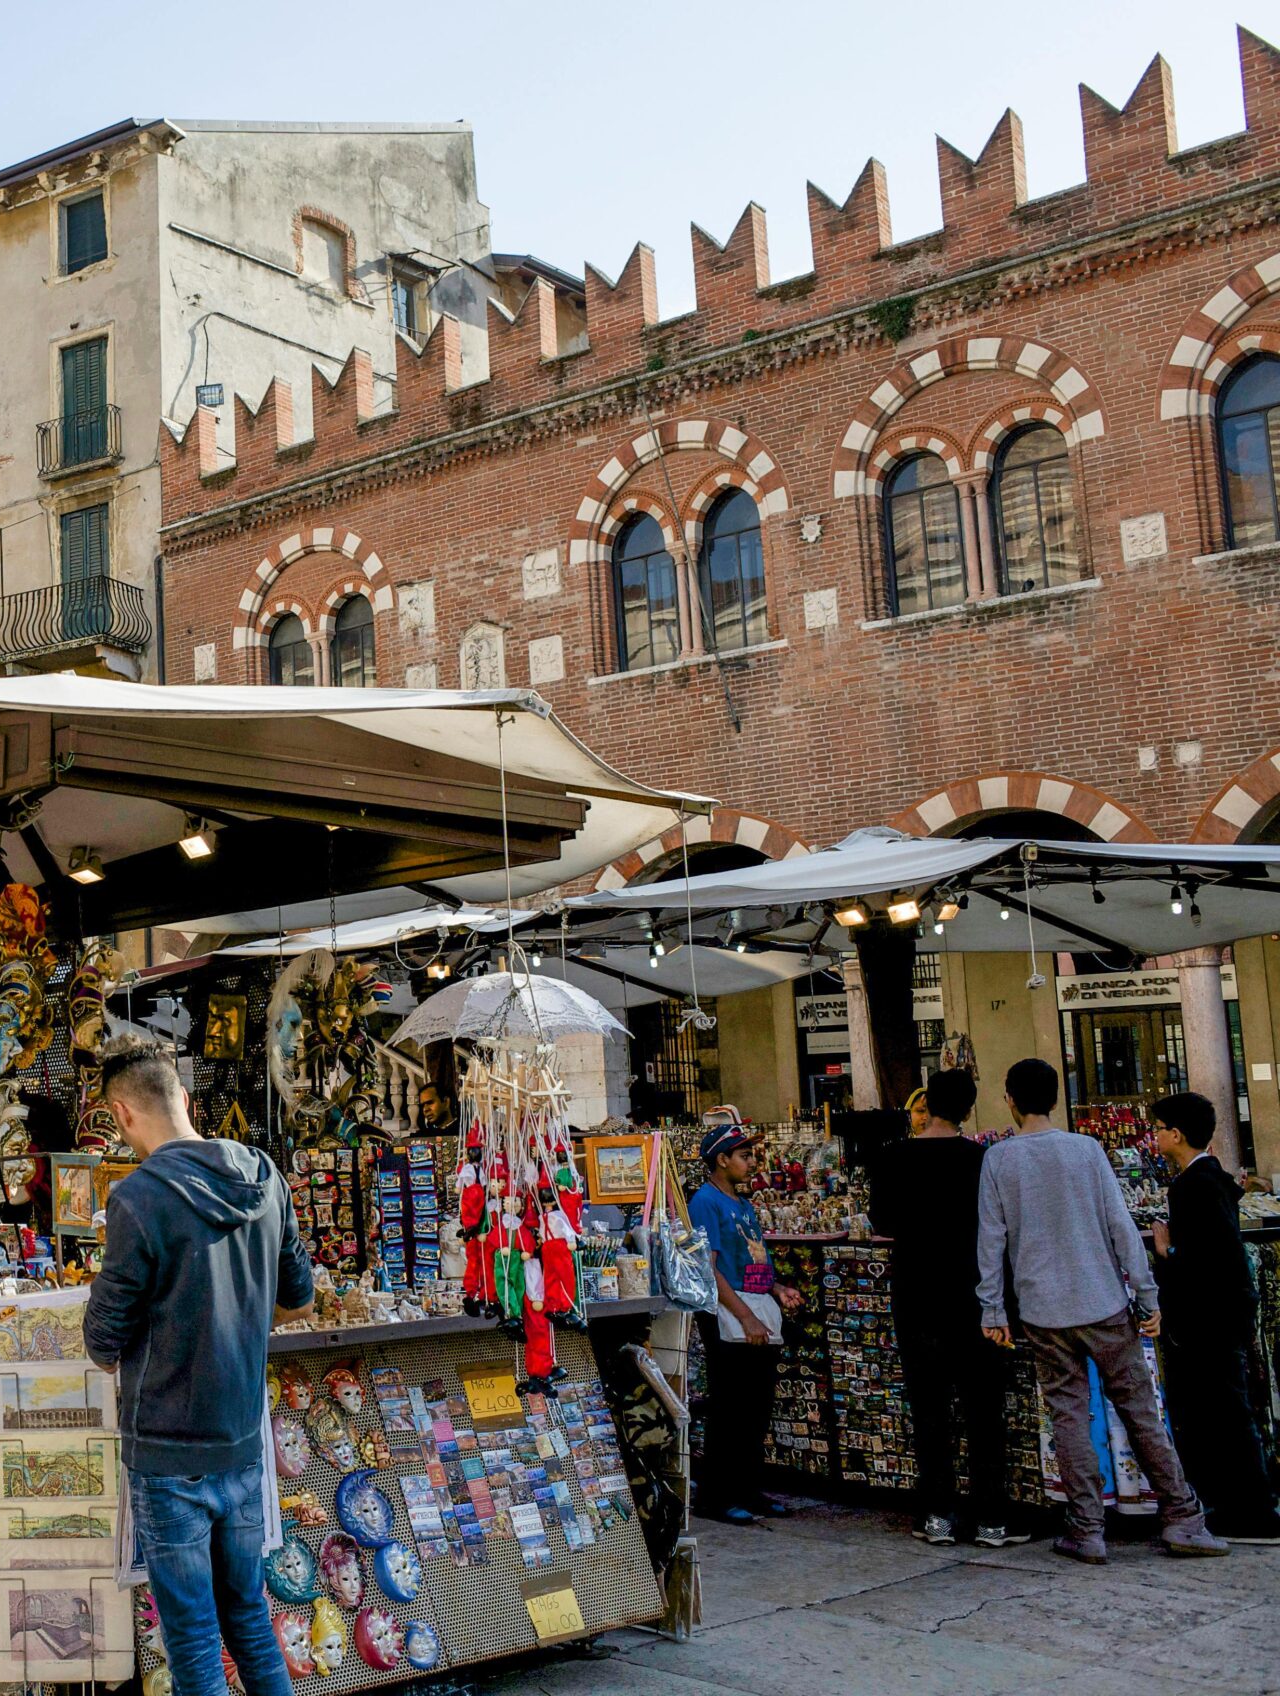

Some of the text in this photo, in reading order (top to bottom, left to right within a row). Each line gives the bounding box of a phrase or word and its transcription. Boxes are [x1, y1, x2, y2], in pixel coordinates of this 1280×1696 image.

[1080, 979, 1137, 990] BANCA
[1081, 987, 1172, 1000] DI VERONA
[470, 1378, 495, 1391] MAGS
[471, 1397, 481, 1411] €
[530, 1594, 560, 1612] MAGS
